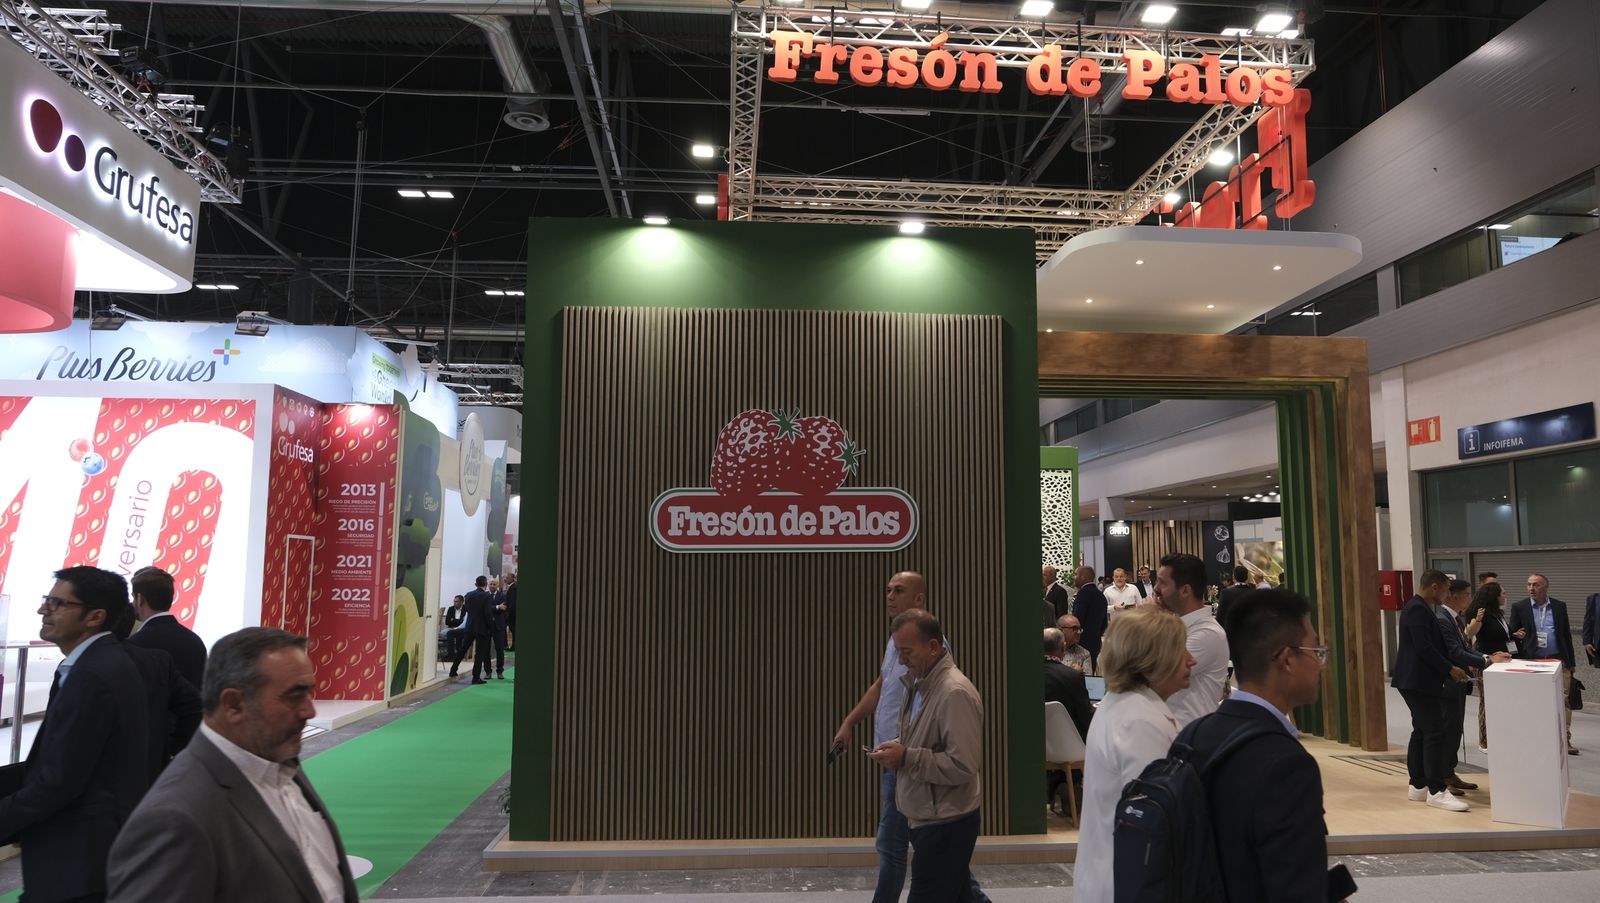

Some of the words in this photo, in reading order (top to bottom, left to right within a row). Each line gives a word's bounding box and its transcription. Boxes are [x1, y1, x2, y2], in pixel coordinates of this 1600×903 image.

[768, 32, 1003, 93] Fresón
[1026, 44, 1101, 98] de
[1121, 49, 1295, 106] Palos
[94, 146, 194, 244] Grufesa
[103, 346, 216, 382] Berries
[277, 435, 314, 463] Grufesa
[1483, 437, 1524, 451] INFOIFEMA
[341, 483, 377, 496] 2013
[338, 518, 375, 531] 2016
[667, 504, 777, 537] Fresón
[779, 504, 817, 537] de
[819, 504, 900, 537] Palos
[336, 555, 372, 568] 2021
[331, 588, 371, 601] 2022
